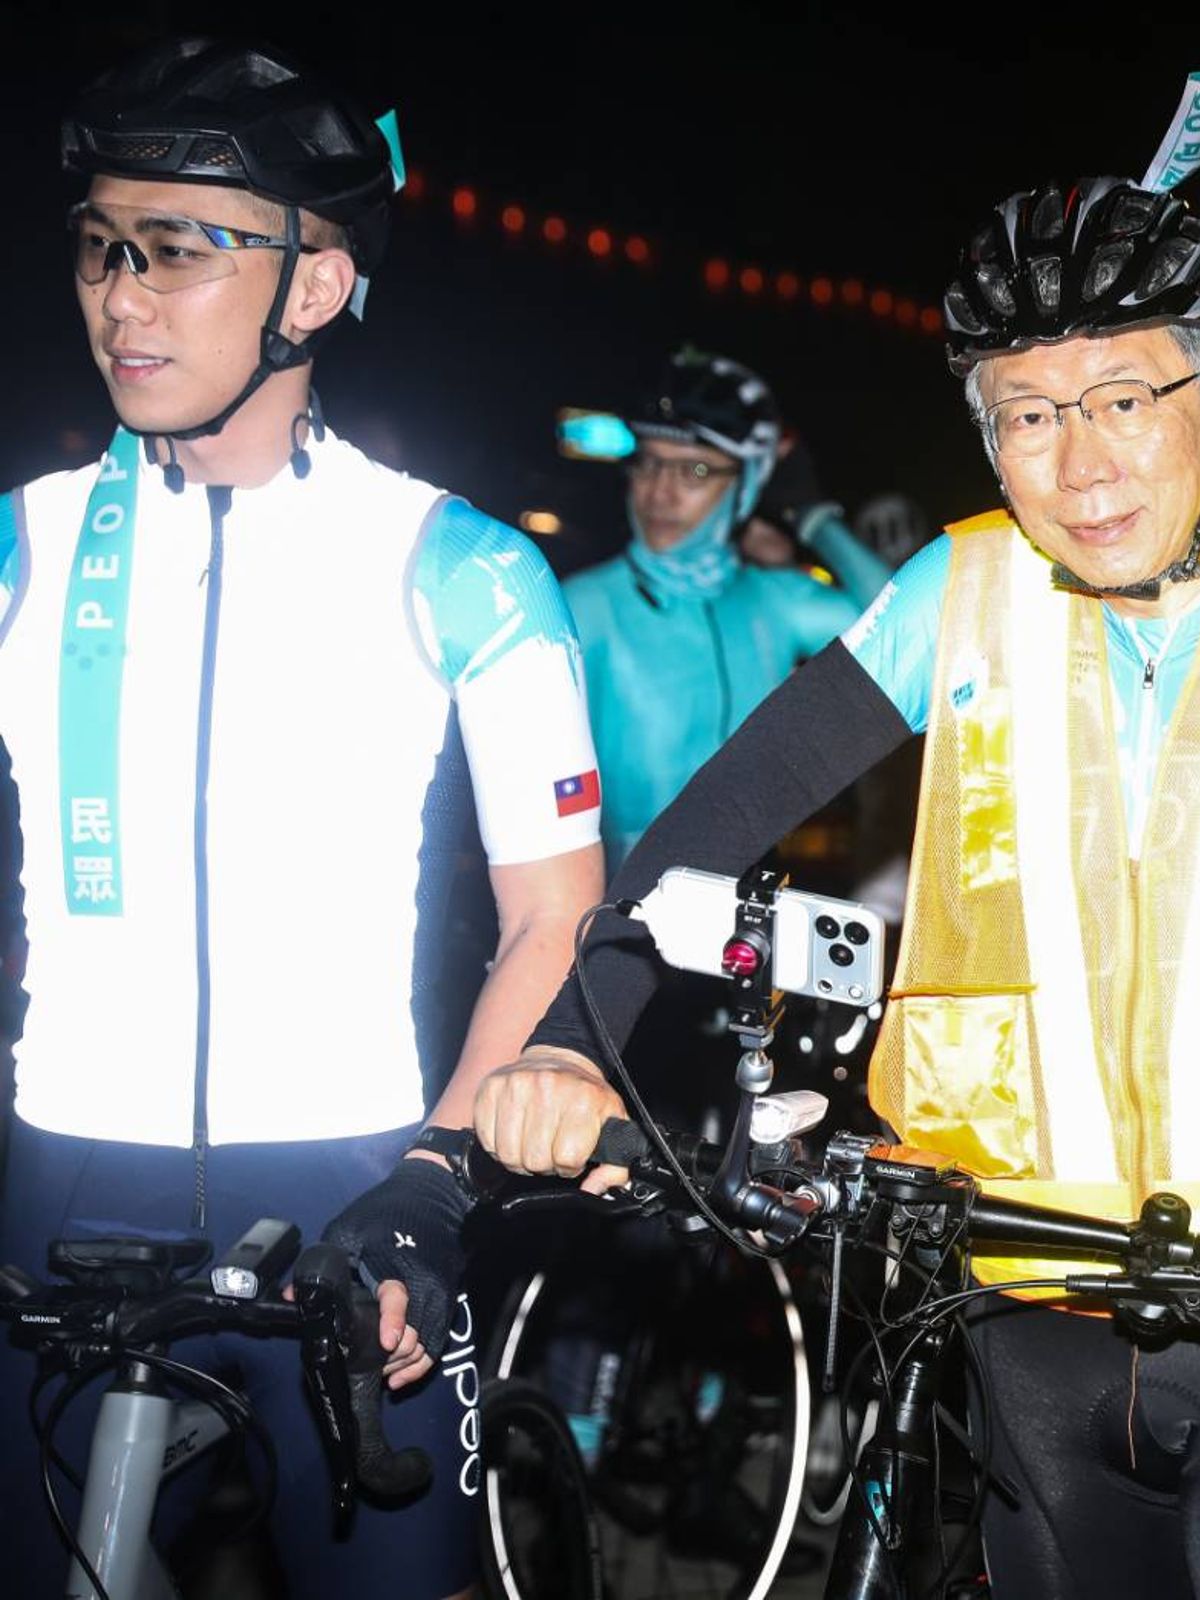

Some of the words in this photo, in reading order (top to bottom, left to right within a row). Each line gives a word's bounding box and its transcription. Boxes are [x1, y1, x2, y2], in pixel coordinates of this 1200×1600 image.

[71, 797, 117, 904] 民眾
[876, 1165, 915, 1179] GARMIN
[21, 1314, 61, 1324] GARMIN
